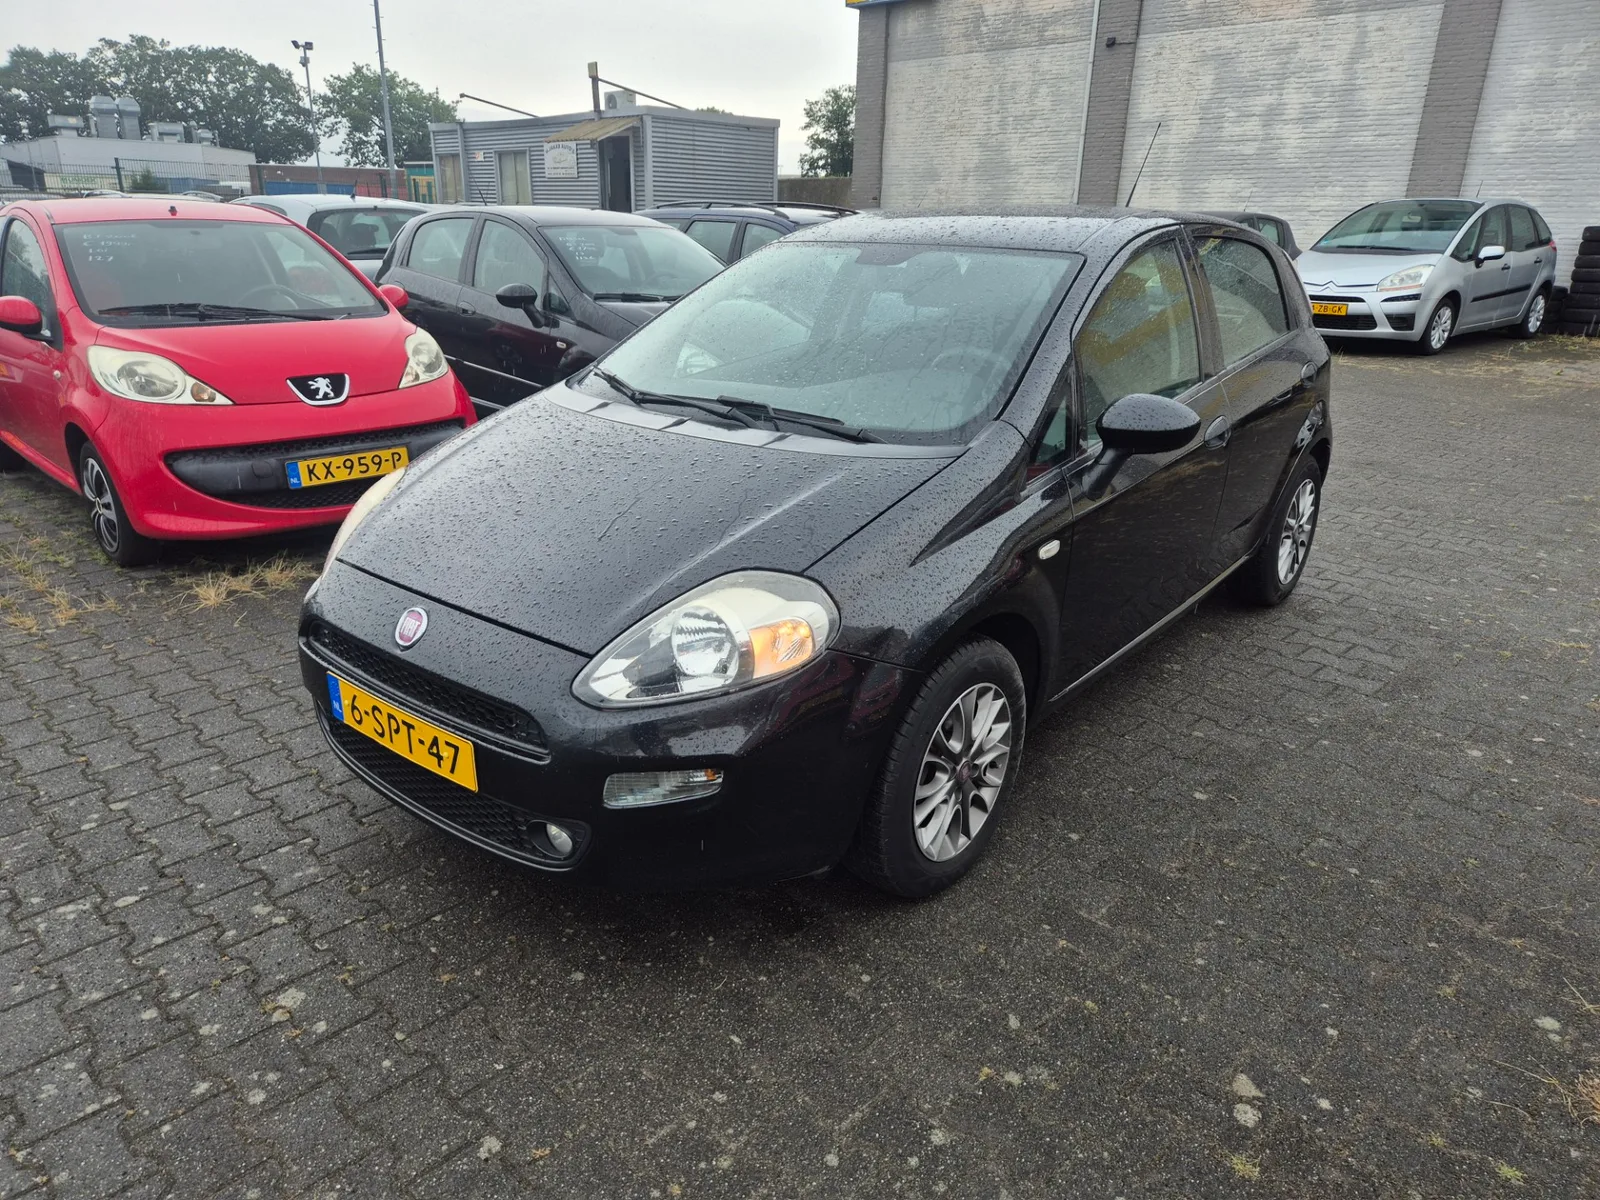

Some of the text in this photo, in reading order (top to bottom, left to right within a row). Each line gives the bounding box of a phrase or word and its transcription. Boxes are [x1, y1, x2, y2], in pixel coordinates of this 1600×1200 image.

[307, 451, 402, 481] KX-959-P
[333, 694, 460, 774] NL 6-SPT-47
